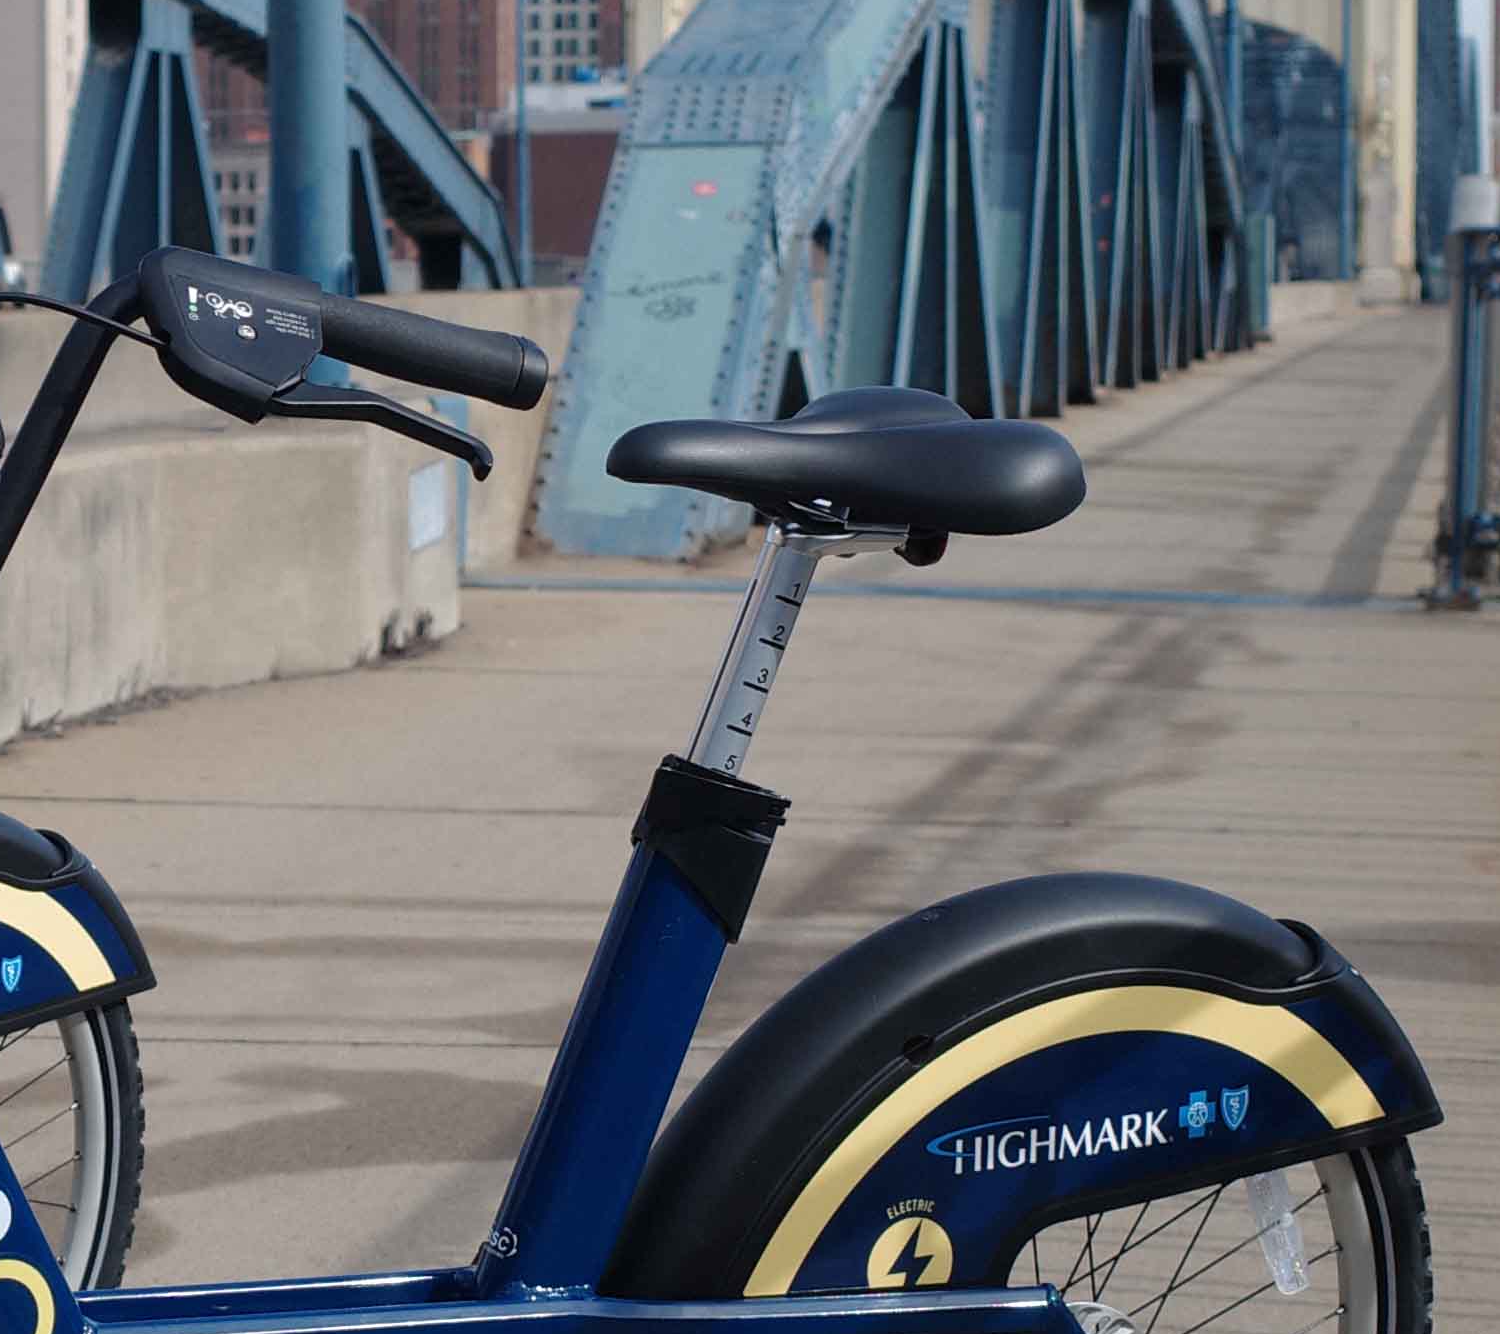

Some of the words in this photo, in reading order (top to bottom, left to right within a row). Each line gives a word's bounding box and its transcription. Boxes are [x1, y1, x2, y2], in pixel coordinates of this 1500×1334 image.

[792, 583, 801, 598] 1
[772, 625, 785, 641] 2
[757, 668, 769, 684] 3
[741, 712, 753, 727] 4
[724, 754, 738, 771] 5
[955, 1109, 1168, 1175] HIGHMARK
[886, 1198, 936, 1220] ELECTRIC
